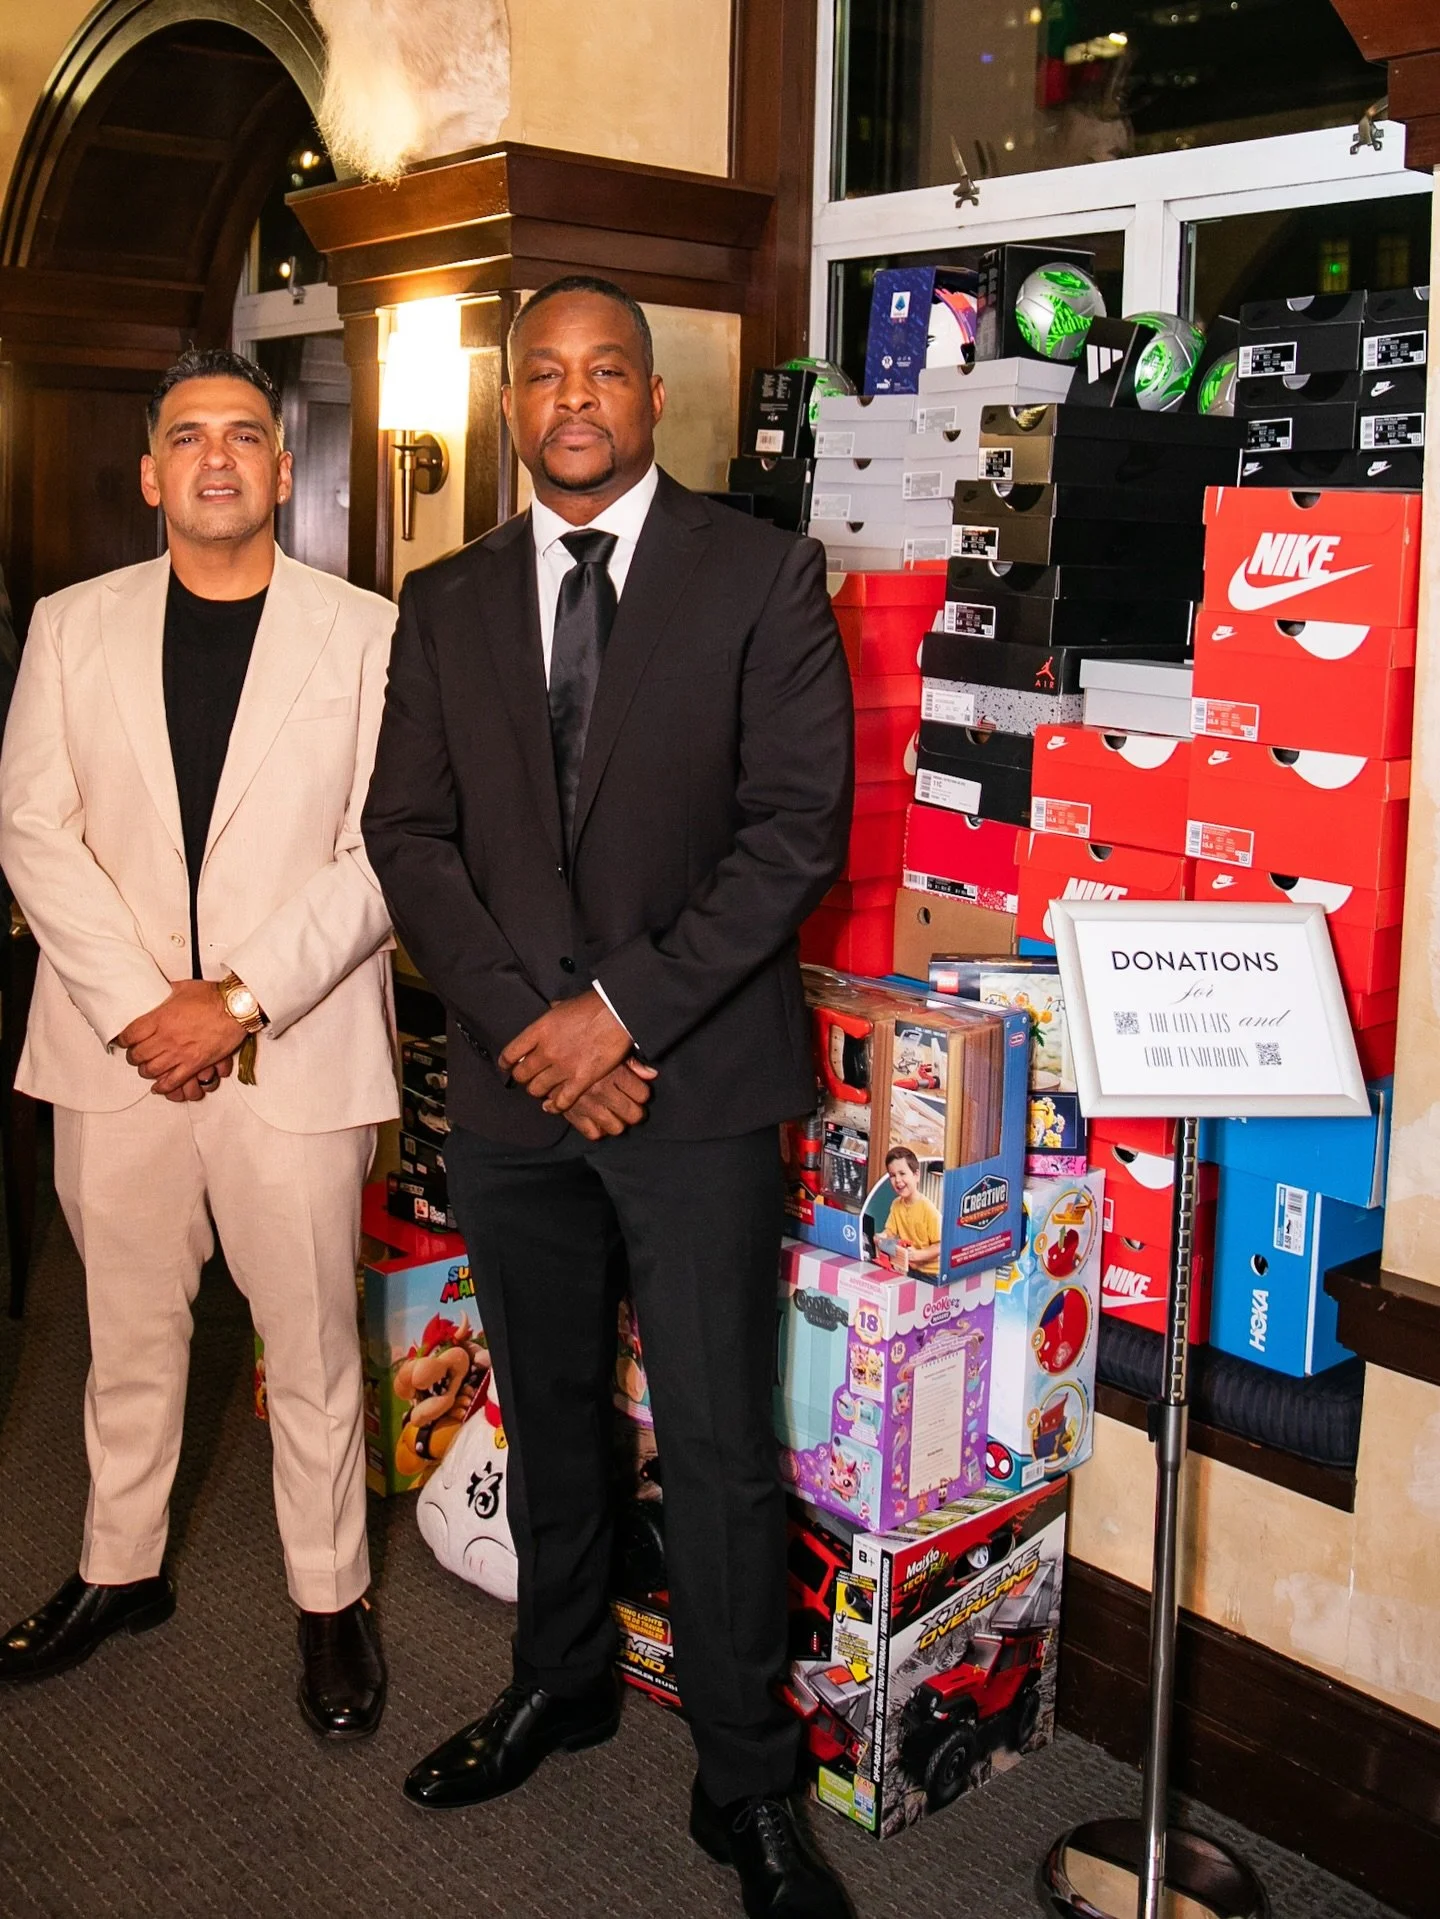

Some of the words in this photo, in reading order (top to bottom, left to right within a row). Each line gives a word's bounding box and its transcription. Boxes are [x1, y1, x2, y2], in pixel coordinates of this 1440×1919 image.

[1247, 531, 1342, 577] NIKE
[1035, 680, 1055, 689] AIR
[1112, 951, 1279, 972] DONATIONS
[1238, 1009, 1291, 1028] and
[447, 1265, 472, 1282] SU
[1102, 1264, 1152, 1299] NIKE
[858, 1311, 879, 1332] 18
[1249, 1289, 1269, 1352] HOKA
[893, 1344, 903, 1355] 18
[906, 1546, 940, 1580] Maisto
[903, 1571, 927, 1593] TECH
[920, 1560, 1039, 1649] OVERLAND
[637, 1612, 663, 1626] LIGHTS
[873, 1744, 882, 1782] OFF-ROAD
